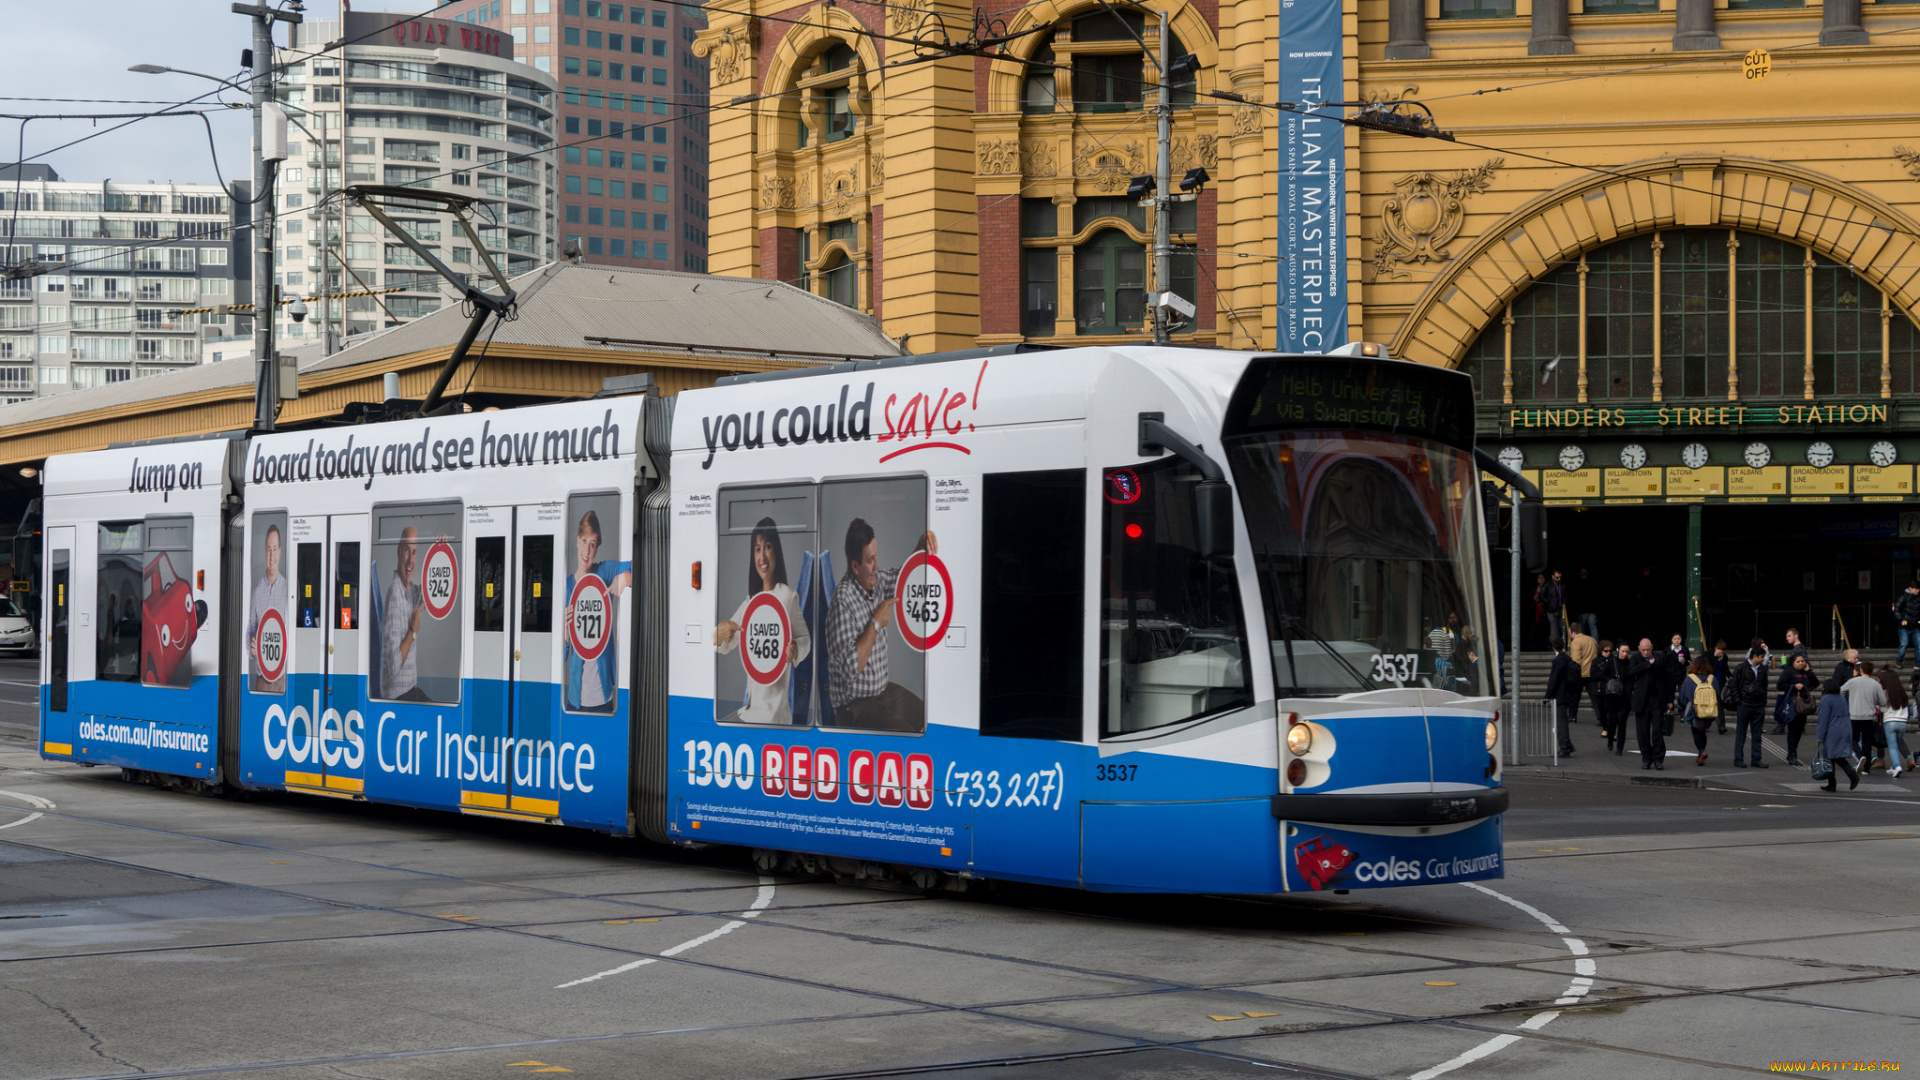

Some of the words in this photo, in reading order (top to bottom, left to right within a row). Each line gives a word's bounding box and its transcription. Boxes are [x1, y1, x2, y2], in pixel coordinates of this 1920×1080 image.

[393, 20, 447, 45] QUAY
[460, 27, 499, 55] WEST
[1744, 53, 1767, 66] CUT
[1746, 67, 1768, 80] OFF
[1288, 118, 1296, 144] FROM
[1302, 78, 1322, 175] ITALIAN
[1288, 183, 1296, 214] ROYAL
[1288, 216, 1297, 250] COURT,
[1289, 253, 1297, 285] MUSEO
[1329, 239, 1337, 297] MASTERPIECES
[1289, 288, 1297, 306] DEL
[1289, 308, 1297, 340] PRADO
[1281, 374, 1322, 397] Melb
[1331, 379, 1424, 405] University
[701, 410, 765, 470] you
[772, 381, 875, 447] could
[877, 360, 988, 443] save!
[1277, 400, 1305, 419] via
[1313, 401, 1400, 425] Swanston
[1510, 408, 1626, 428] FLINDERS
[1657, 406, 1748, 426] STREET
[1778, 403, 1888, 425] STATION
[129, 457, 176, 503] Jump
[179, 461, 203, 490] on
[253, 438, 312, 484] board
[315, 434, 379, 490] today
[382, 426, 431, 475] and
[432, 437, 474, 472] see
[480, 420, 539, 468] how
[543, 408, 619, 465] much
[1545, 471, 1588, 479] SANDRINGHAM
[1817, 520, 1860, 532] Customer
[1863, 518, 1898, 529] Service
[429, 567, 432, 578] I
[432, 566, 451, 578] SAVED
[429, 579, 450, 598] $242
[907, 584, 910, 598] I
[911, 584, 942, 598] SAVED
[577, 600, 580, 612] I
[580, 600, 603, 612] SAVED
[906, 598, 940, 623] $463
[262, 632, 265, 642] I
[265, 632, 281, 643] SAVED
[576, 613, 602, 639] $121
[750, 623, 753, 636] I
[753, 623, 780, 636] SAVED
[262, 643, 281, 661] $100
[749, 637, 780, 660] $468
[1370, 653, 1419, 682] 3537
[79, 714, 209, 753] coles.com.au/insurance
[263, 689, 365, 770] coles
[376, 711, 428, 775] Car
[435, 714, 595, 793] Insurance
[683, 740, 755, 790] 1300
[763, 747, 839, 798] RED
[850, 753, 932, 807] CAR
[944, 761, 1002, 808] (733
[1005, 761, 1064, 811] 227)
[1096, 764, 1139, 782] 3537
[1355, 856, 1421, 882] coles
[1425, 858, 1451, 879] Car
[1452, 852, 1500, 876] Insurance
